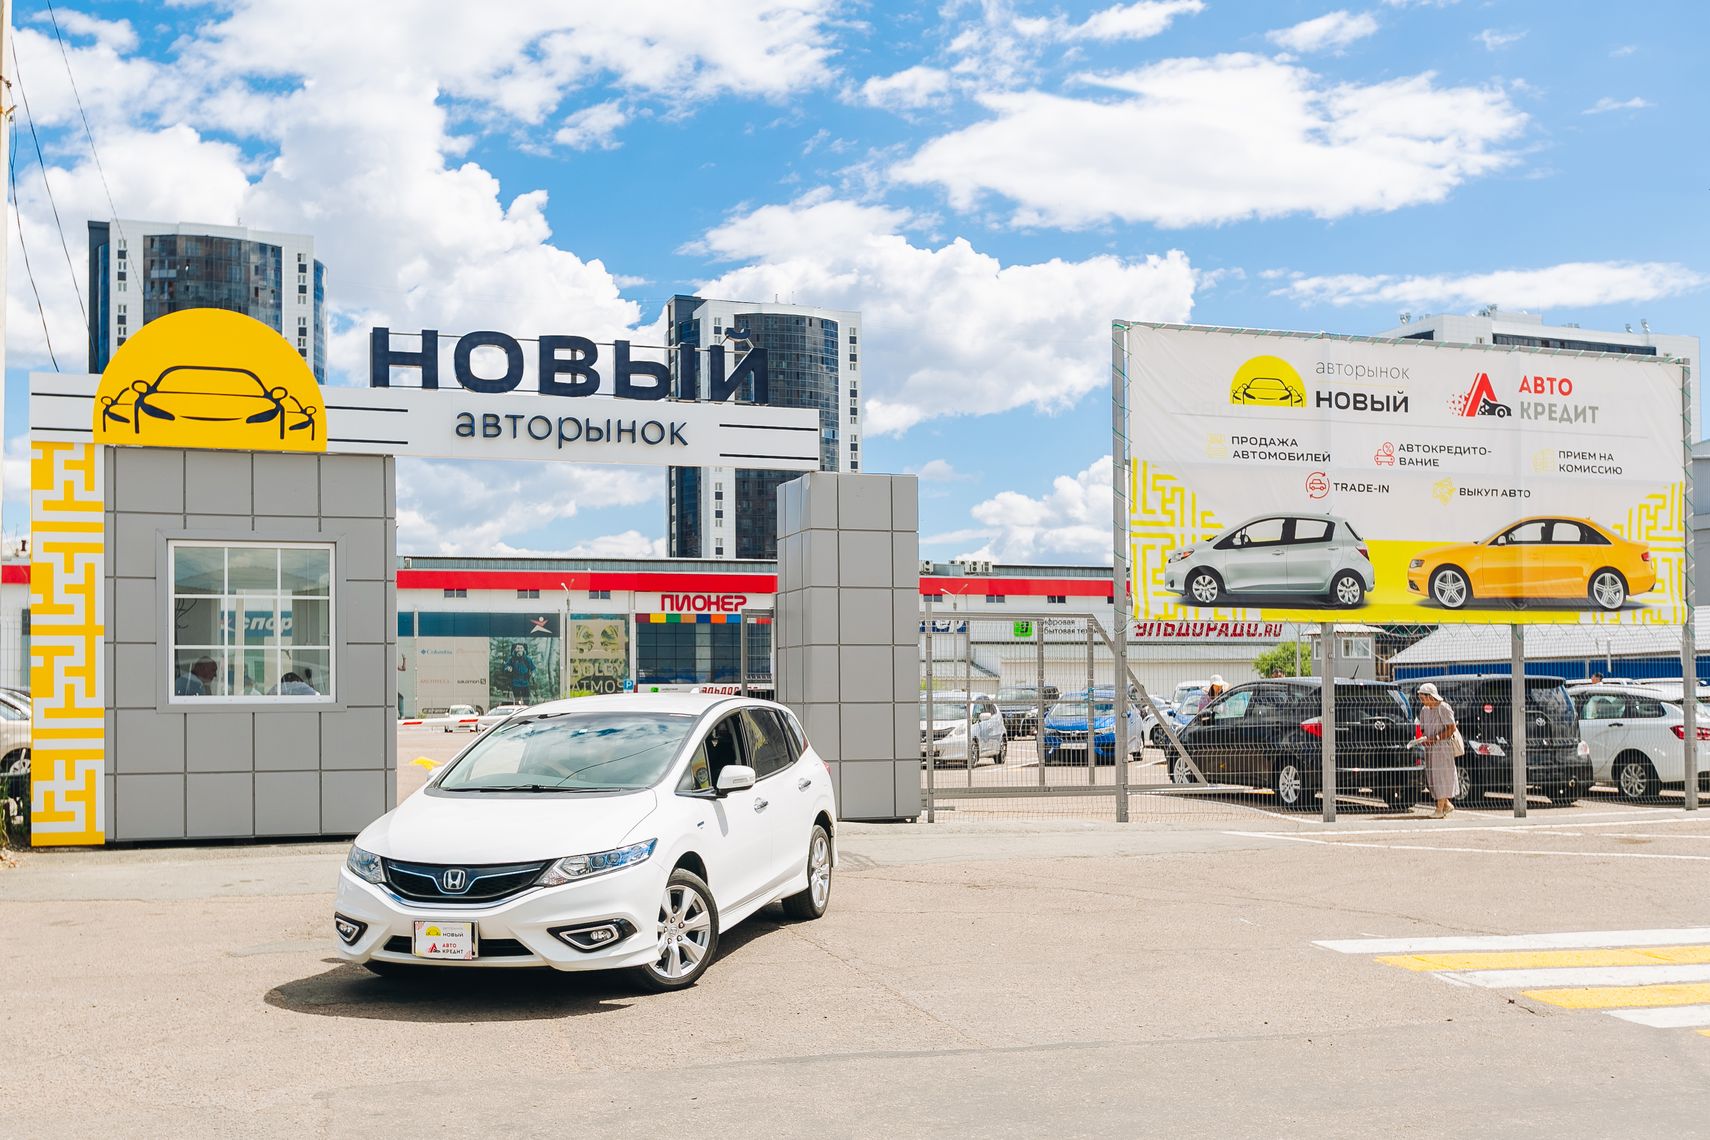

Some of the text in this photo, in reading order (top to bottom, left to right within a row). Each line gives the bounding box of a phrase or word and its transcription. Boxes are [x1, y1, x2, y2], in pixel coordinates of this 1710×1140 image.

[371, 327, 769, 404] НОВЫЙ
[1315, 361, 1410, 380] авторынок
[1518, 375, 1573, 397] АВТО
[1315, 390, 1409, 413] НОВЫЙ
[1519, 402, 1599, 424] КРЕДИТ
[455, 410, 689, 449] авторынок
[1231, 436, 1298, 448] ПРОДАЖА
[1398, 443, 1492, 456] АВТОКРЕДИТО-
[1558, 450, 1614, 462] ПРИЕМ НА
[1232, 450, 1331, 463] АВТОМОБИЛЕЙ
[1399, 457, 1440, 467] ВАНИЕ
[1558, 463, 1623, 475] КОМИССИЮ
[1333, 482, 1390, 493] TRADE-IN
[1459, 487, 1531, 498] ВЫКУП АВТО
[661, 594, 748, 612] ПИОНЕР
